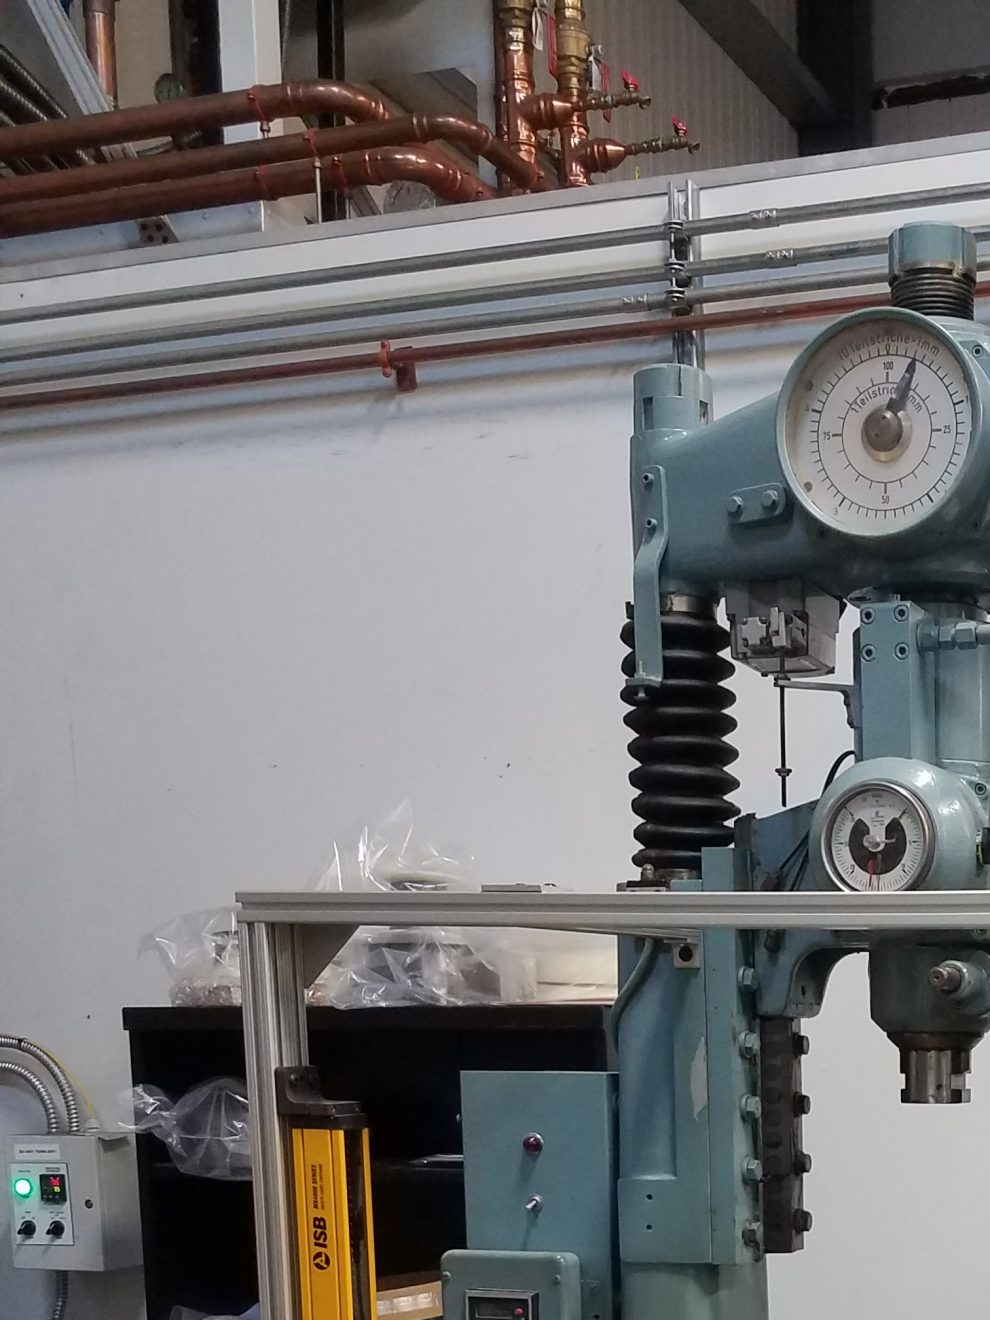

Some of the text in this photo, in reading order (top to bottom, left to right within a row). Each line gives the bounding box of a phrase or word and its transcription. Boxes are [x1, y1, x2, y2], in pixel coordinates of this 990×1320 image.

[883, 361, 894, 370] 100
[943, 425, 951, 434] 25
[823, 431, 831, 441] 75
[881, 495, 890, 504] 50
[312, 1216, 328, 1250] ISB
